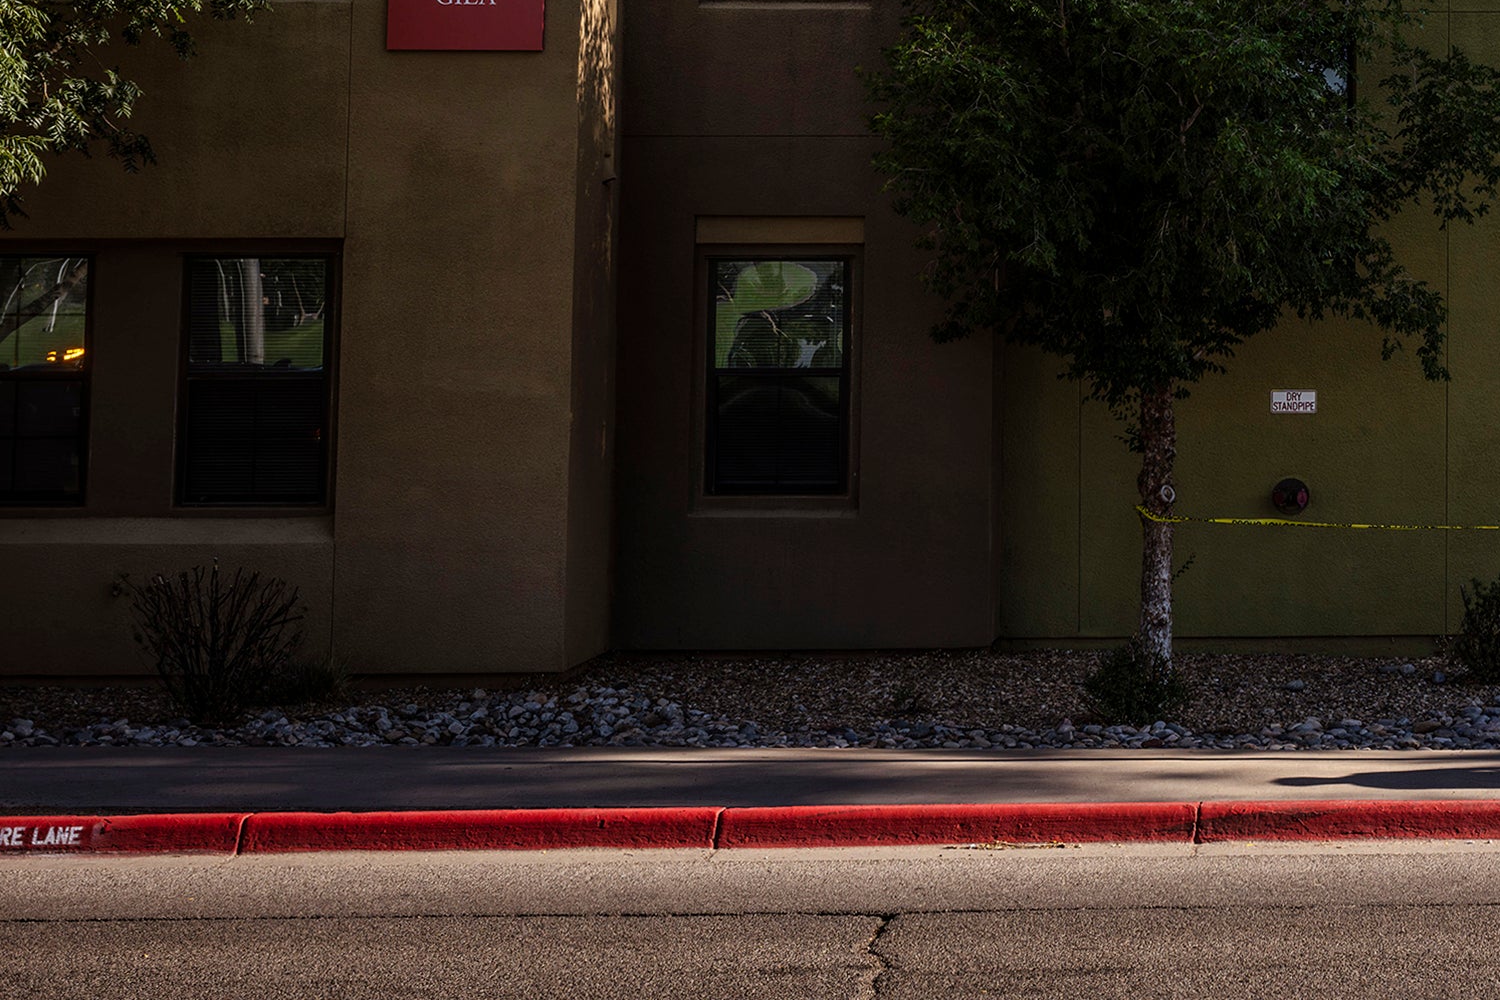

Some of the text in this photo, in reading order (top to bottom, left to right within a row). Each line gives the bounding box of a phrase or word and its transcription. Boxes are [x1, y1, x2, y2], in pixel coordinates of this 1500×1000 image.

[1286, 391, 1303, 401] DRY
[1272, 401, 1315, 411] STANDPIPE
[31, 826, 84, 845] LANE
